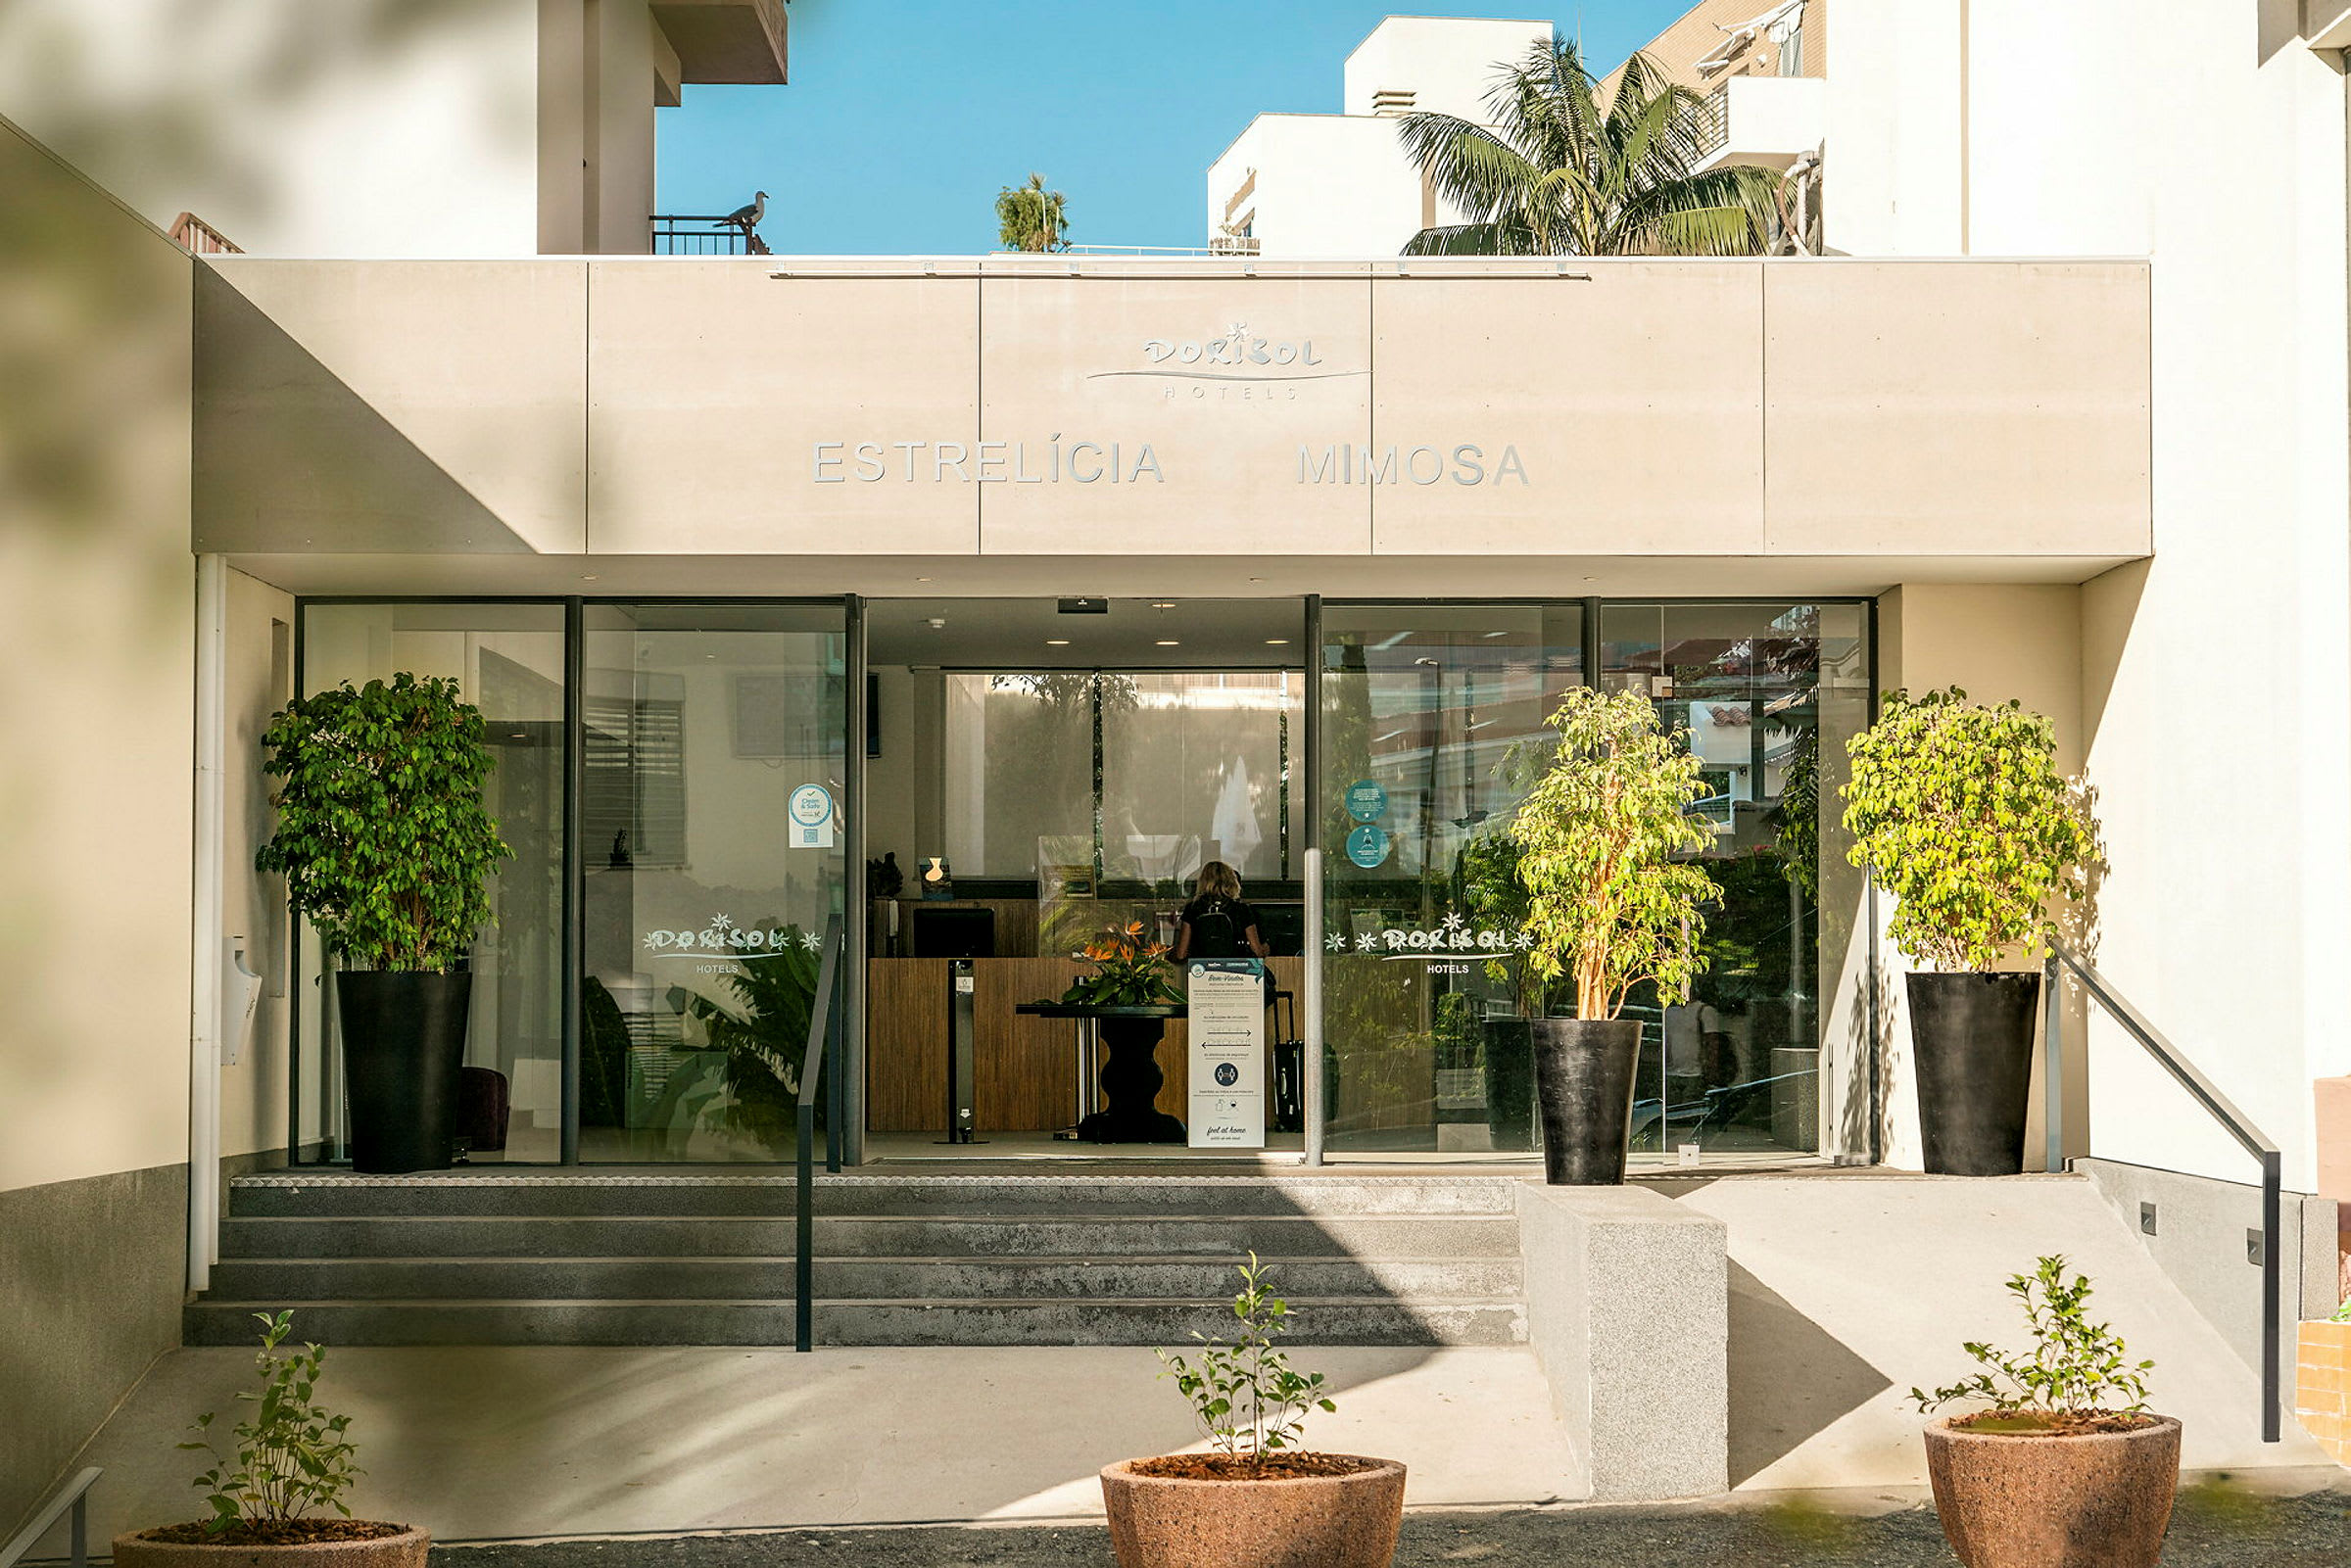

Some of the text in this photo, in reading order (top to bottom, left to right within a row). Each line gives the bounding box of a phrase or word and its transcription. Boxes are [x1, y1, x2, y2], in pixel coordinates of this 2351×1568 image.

[1164, 386, 1298, 401] HOTELS
[812, 432, 1530, 486] ESTRELÍCIA MIMOSA
[696, 964, 739, 974] HOTELS
[1427, 964, 1469, 974] HOTELS
